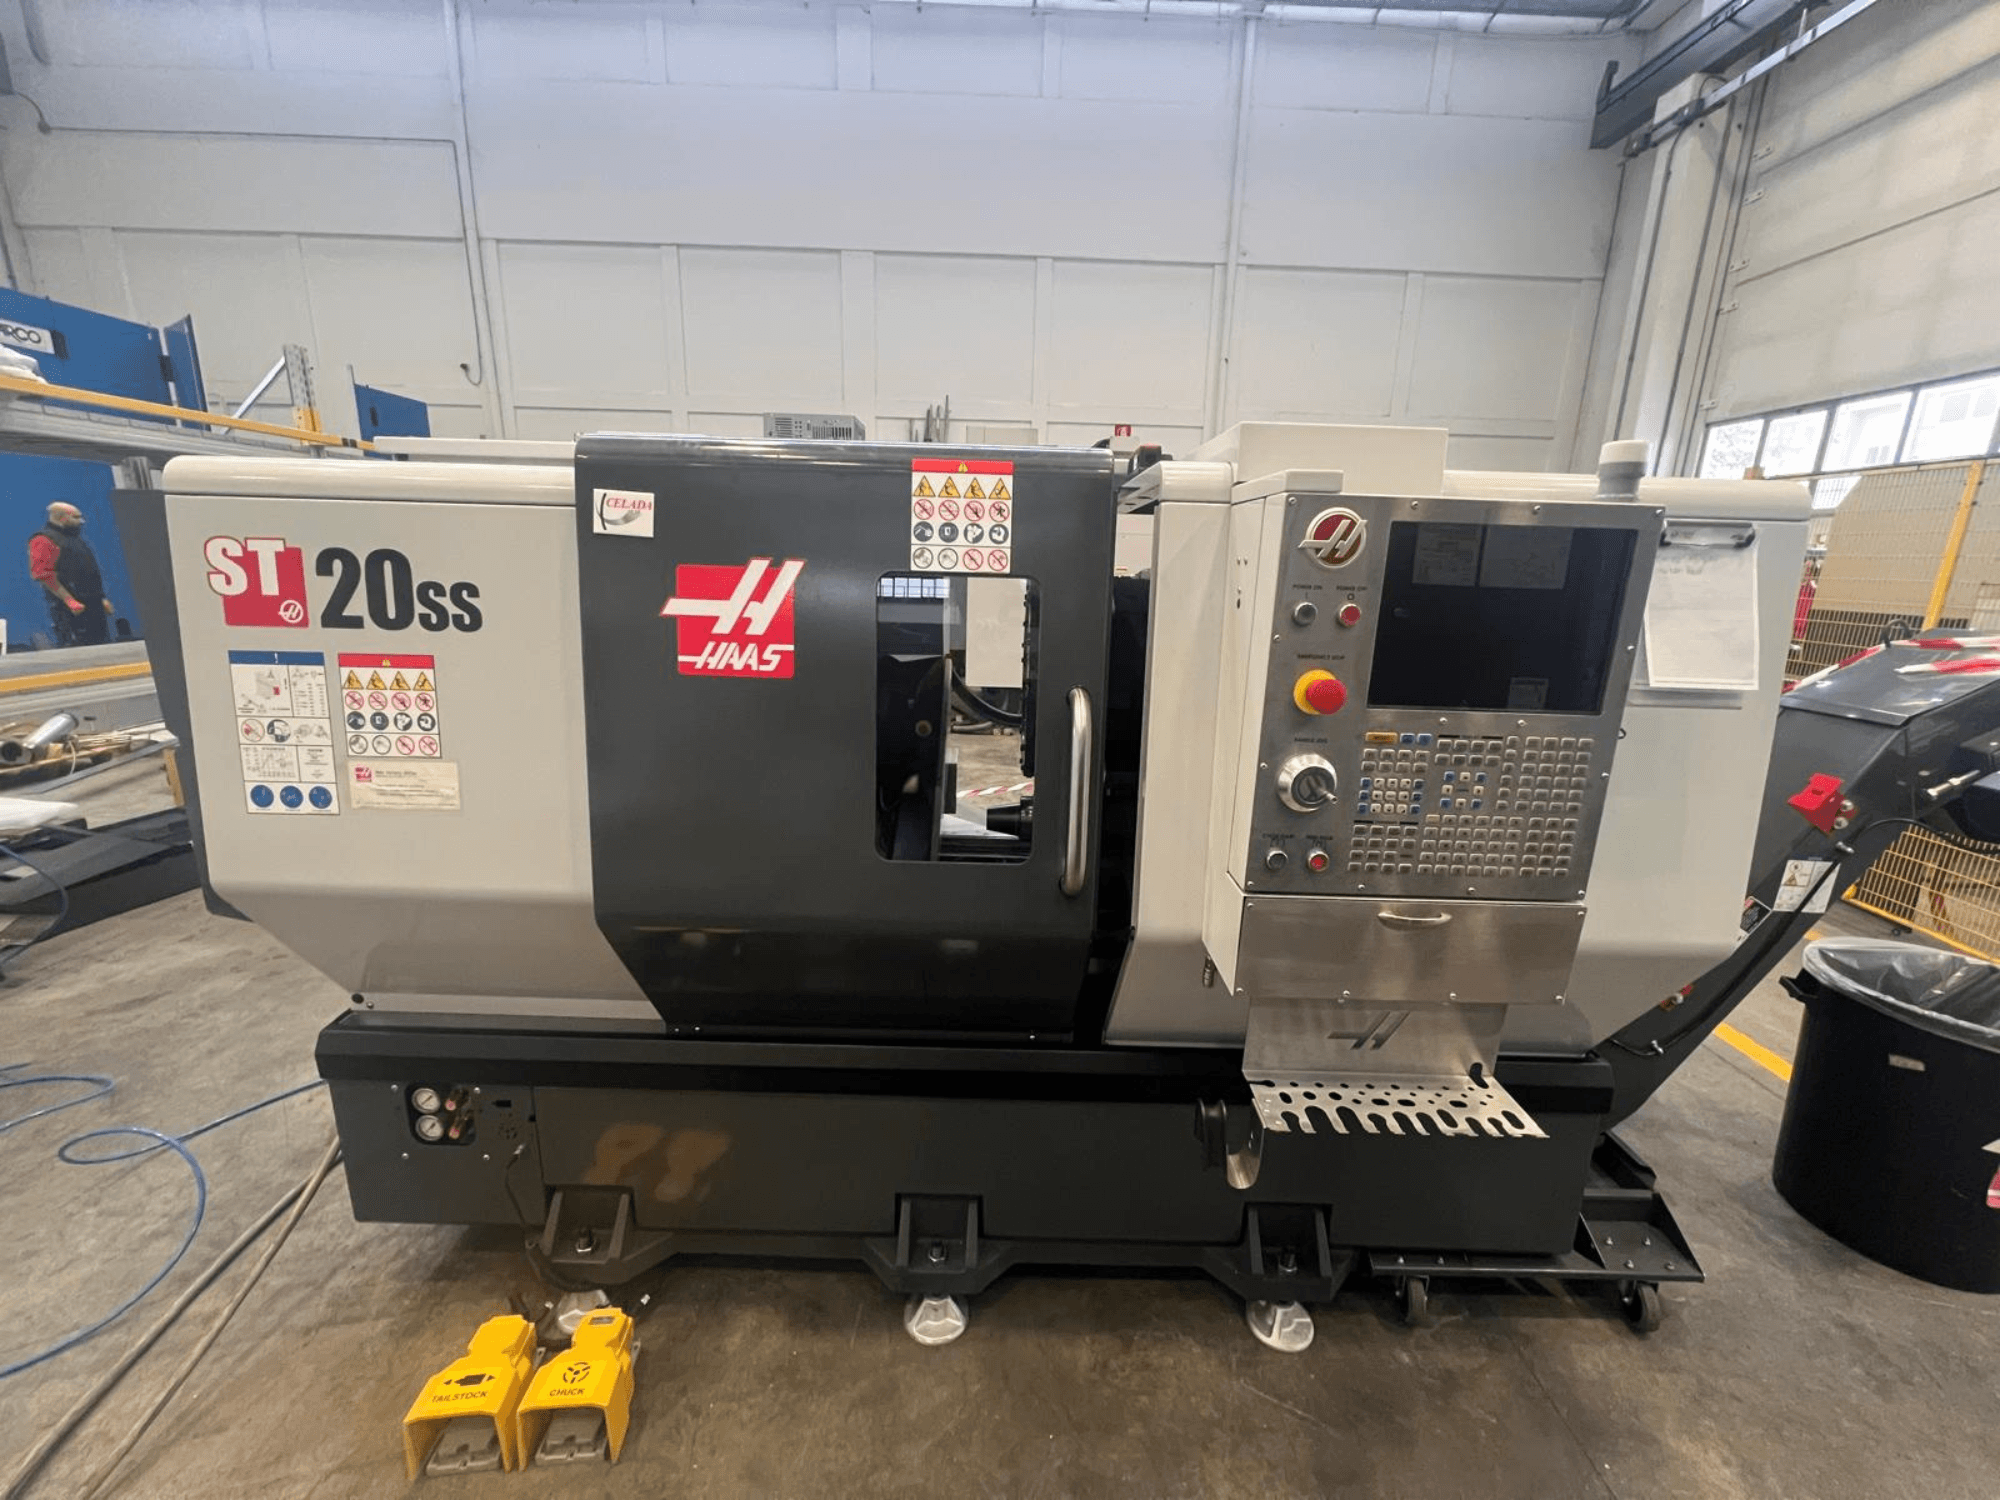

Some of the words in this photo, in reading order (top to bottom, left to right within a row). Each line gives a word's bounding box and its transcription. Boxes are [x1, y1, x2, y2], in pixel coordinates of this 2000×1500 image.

[606, 497, 653, 511] CELADA
[203, 535, 286, 597] ST
[678, 641, 794, 671] HAAS
[432, 1390, 488, 1403] TAILSTOCK
[549, 1387, 586, 1398] CHUCK
